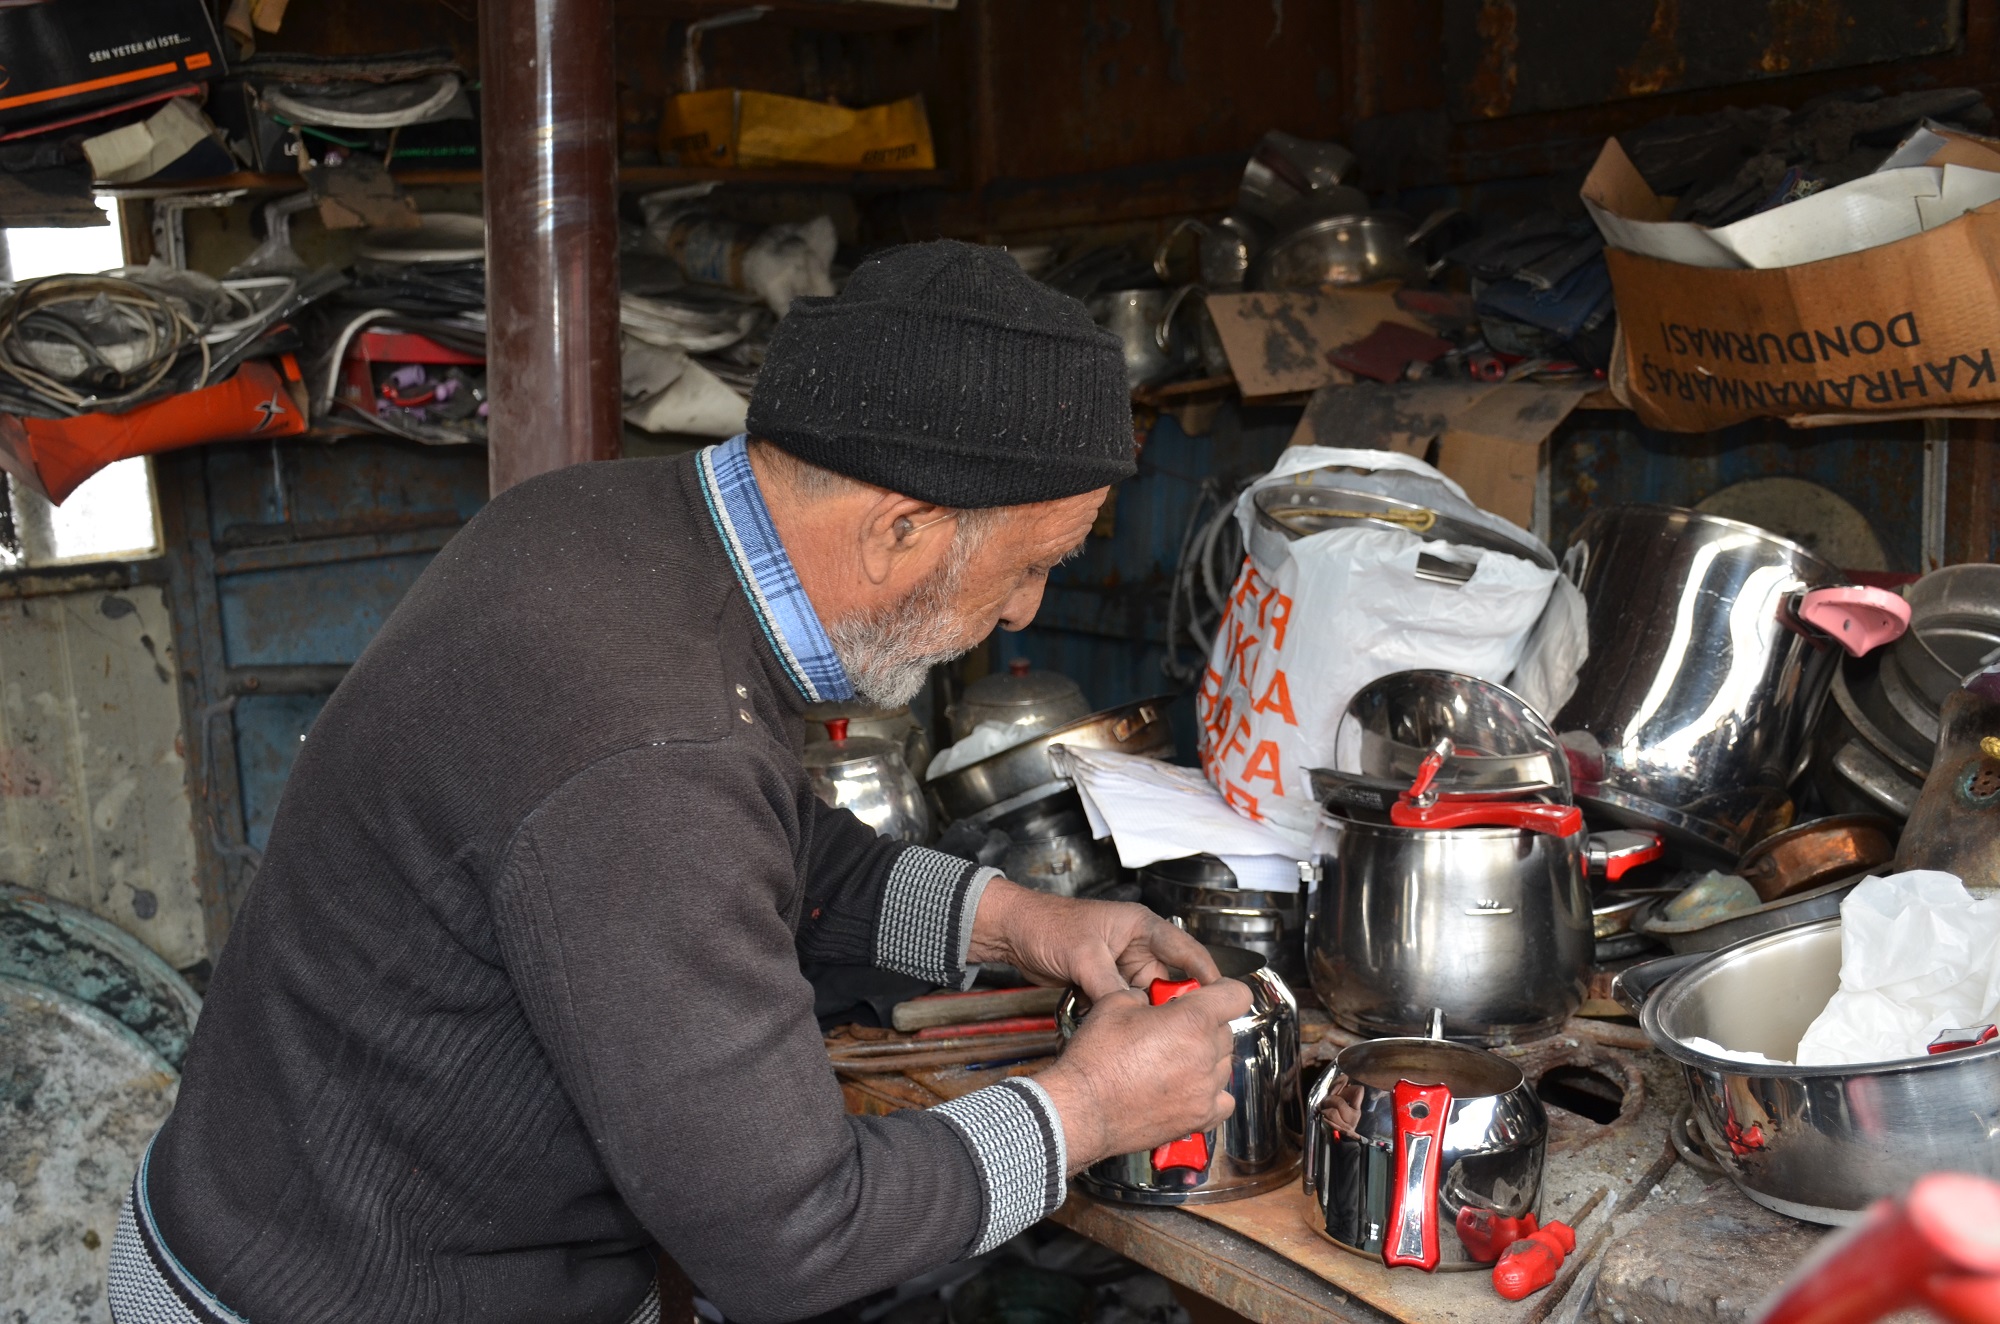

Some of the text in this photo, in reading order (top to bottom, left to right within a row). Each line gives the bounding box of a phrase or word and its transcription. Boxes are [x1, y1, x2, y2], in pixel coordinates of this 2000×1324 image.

[88, 49, 111, 63] SEN
[111, 42, 145, 58] YETER
[145, 37, 158, 51] Kİ
[1660, 311, 1921, 364] DONDURMASI
[1641, 347, 1997, 410] KAHRAMANMARAŞ
